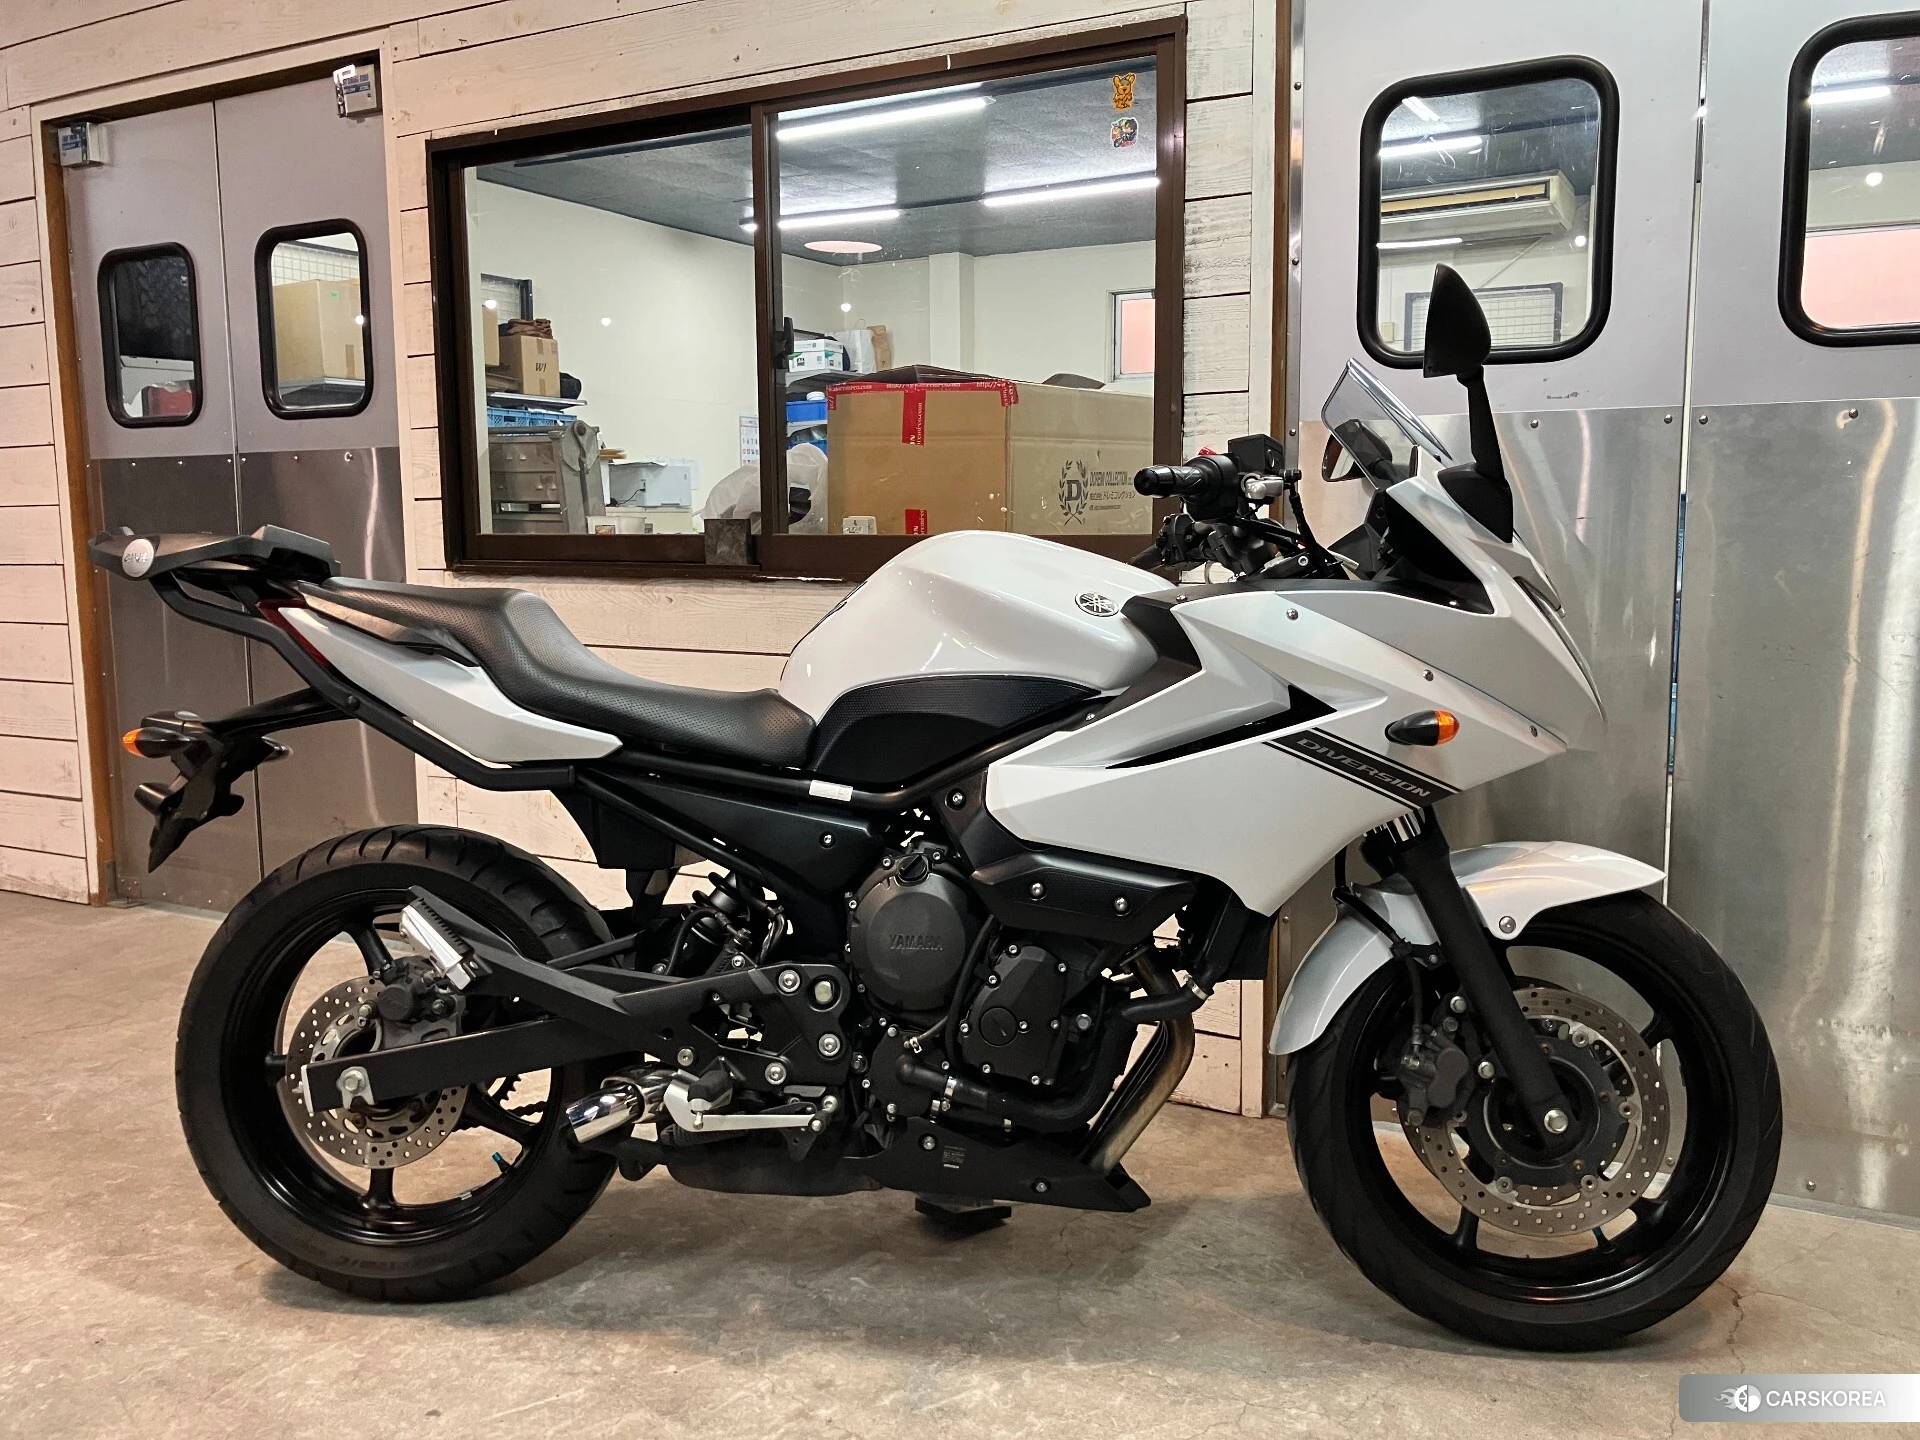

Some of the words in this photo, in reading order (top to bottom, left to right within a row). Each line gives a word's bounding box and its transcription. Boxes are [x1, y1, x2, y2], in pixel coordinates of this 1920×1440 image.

[1066, 479, 1082, 501] D
[1297, 738, 1431, 797] DIVERSION
[890, 934, 943, 950] YAMAHA
